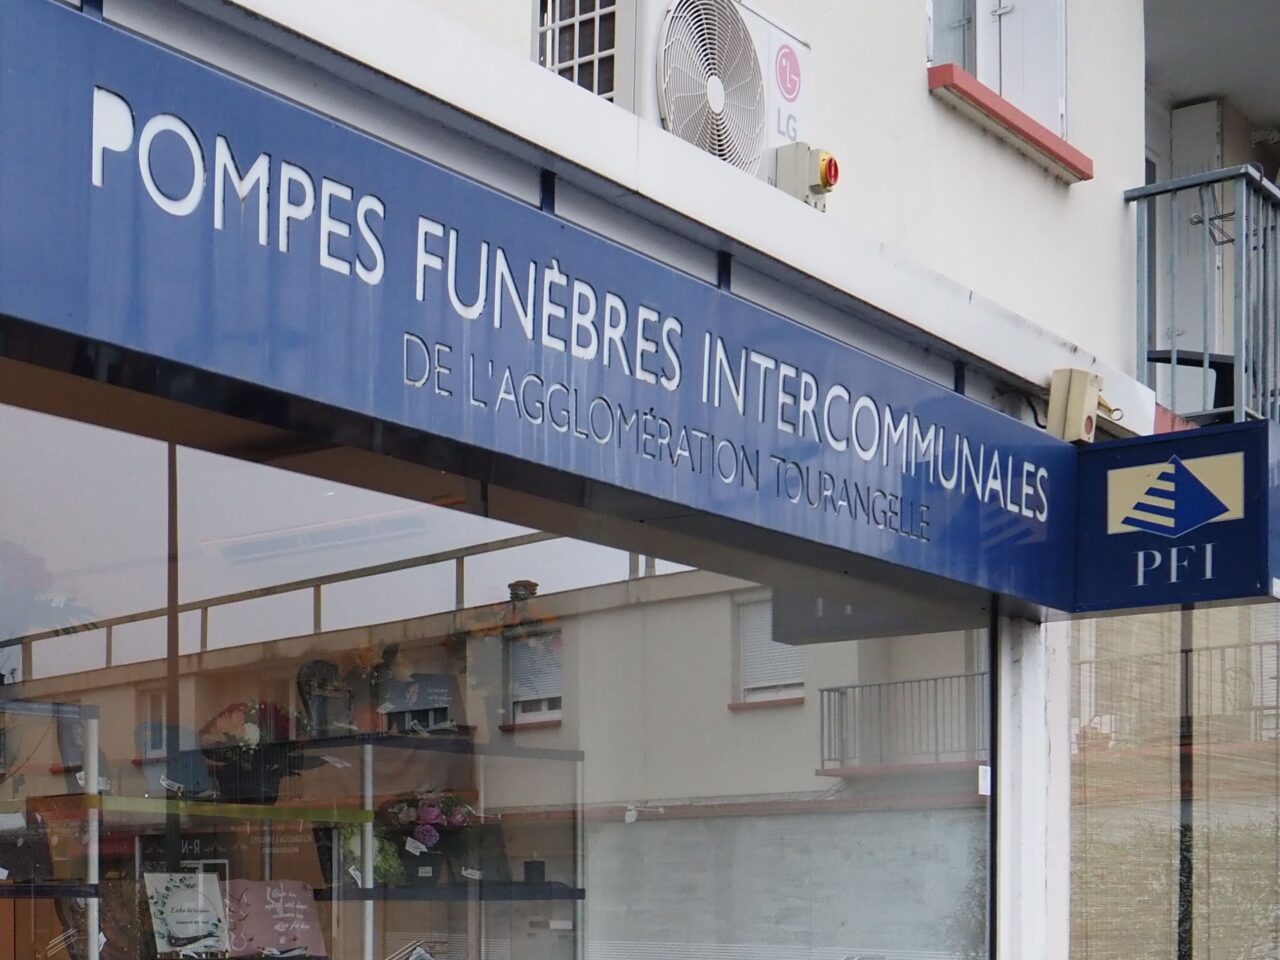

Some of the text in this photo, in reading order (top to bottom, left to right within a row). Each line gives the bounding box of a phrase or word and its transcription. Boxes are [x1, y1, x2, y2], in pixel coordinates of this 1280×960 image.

[777, 107, 798, 142] LG
[91, 85, 1050, 523] POMPES FUNÈBRES INTERCOMMUNALES
[403, 332, 931, 543] DE L'AGGLOMÉRATION TOURANGELLE
[1133, 542, 1217, 588] PFI
